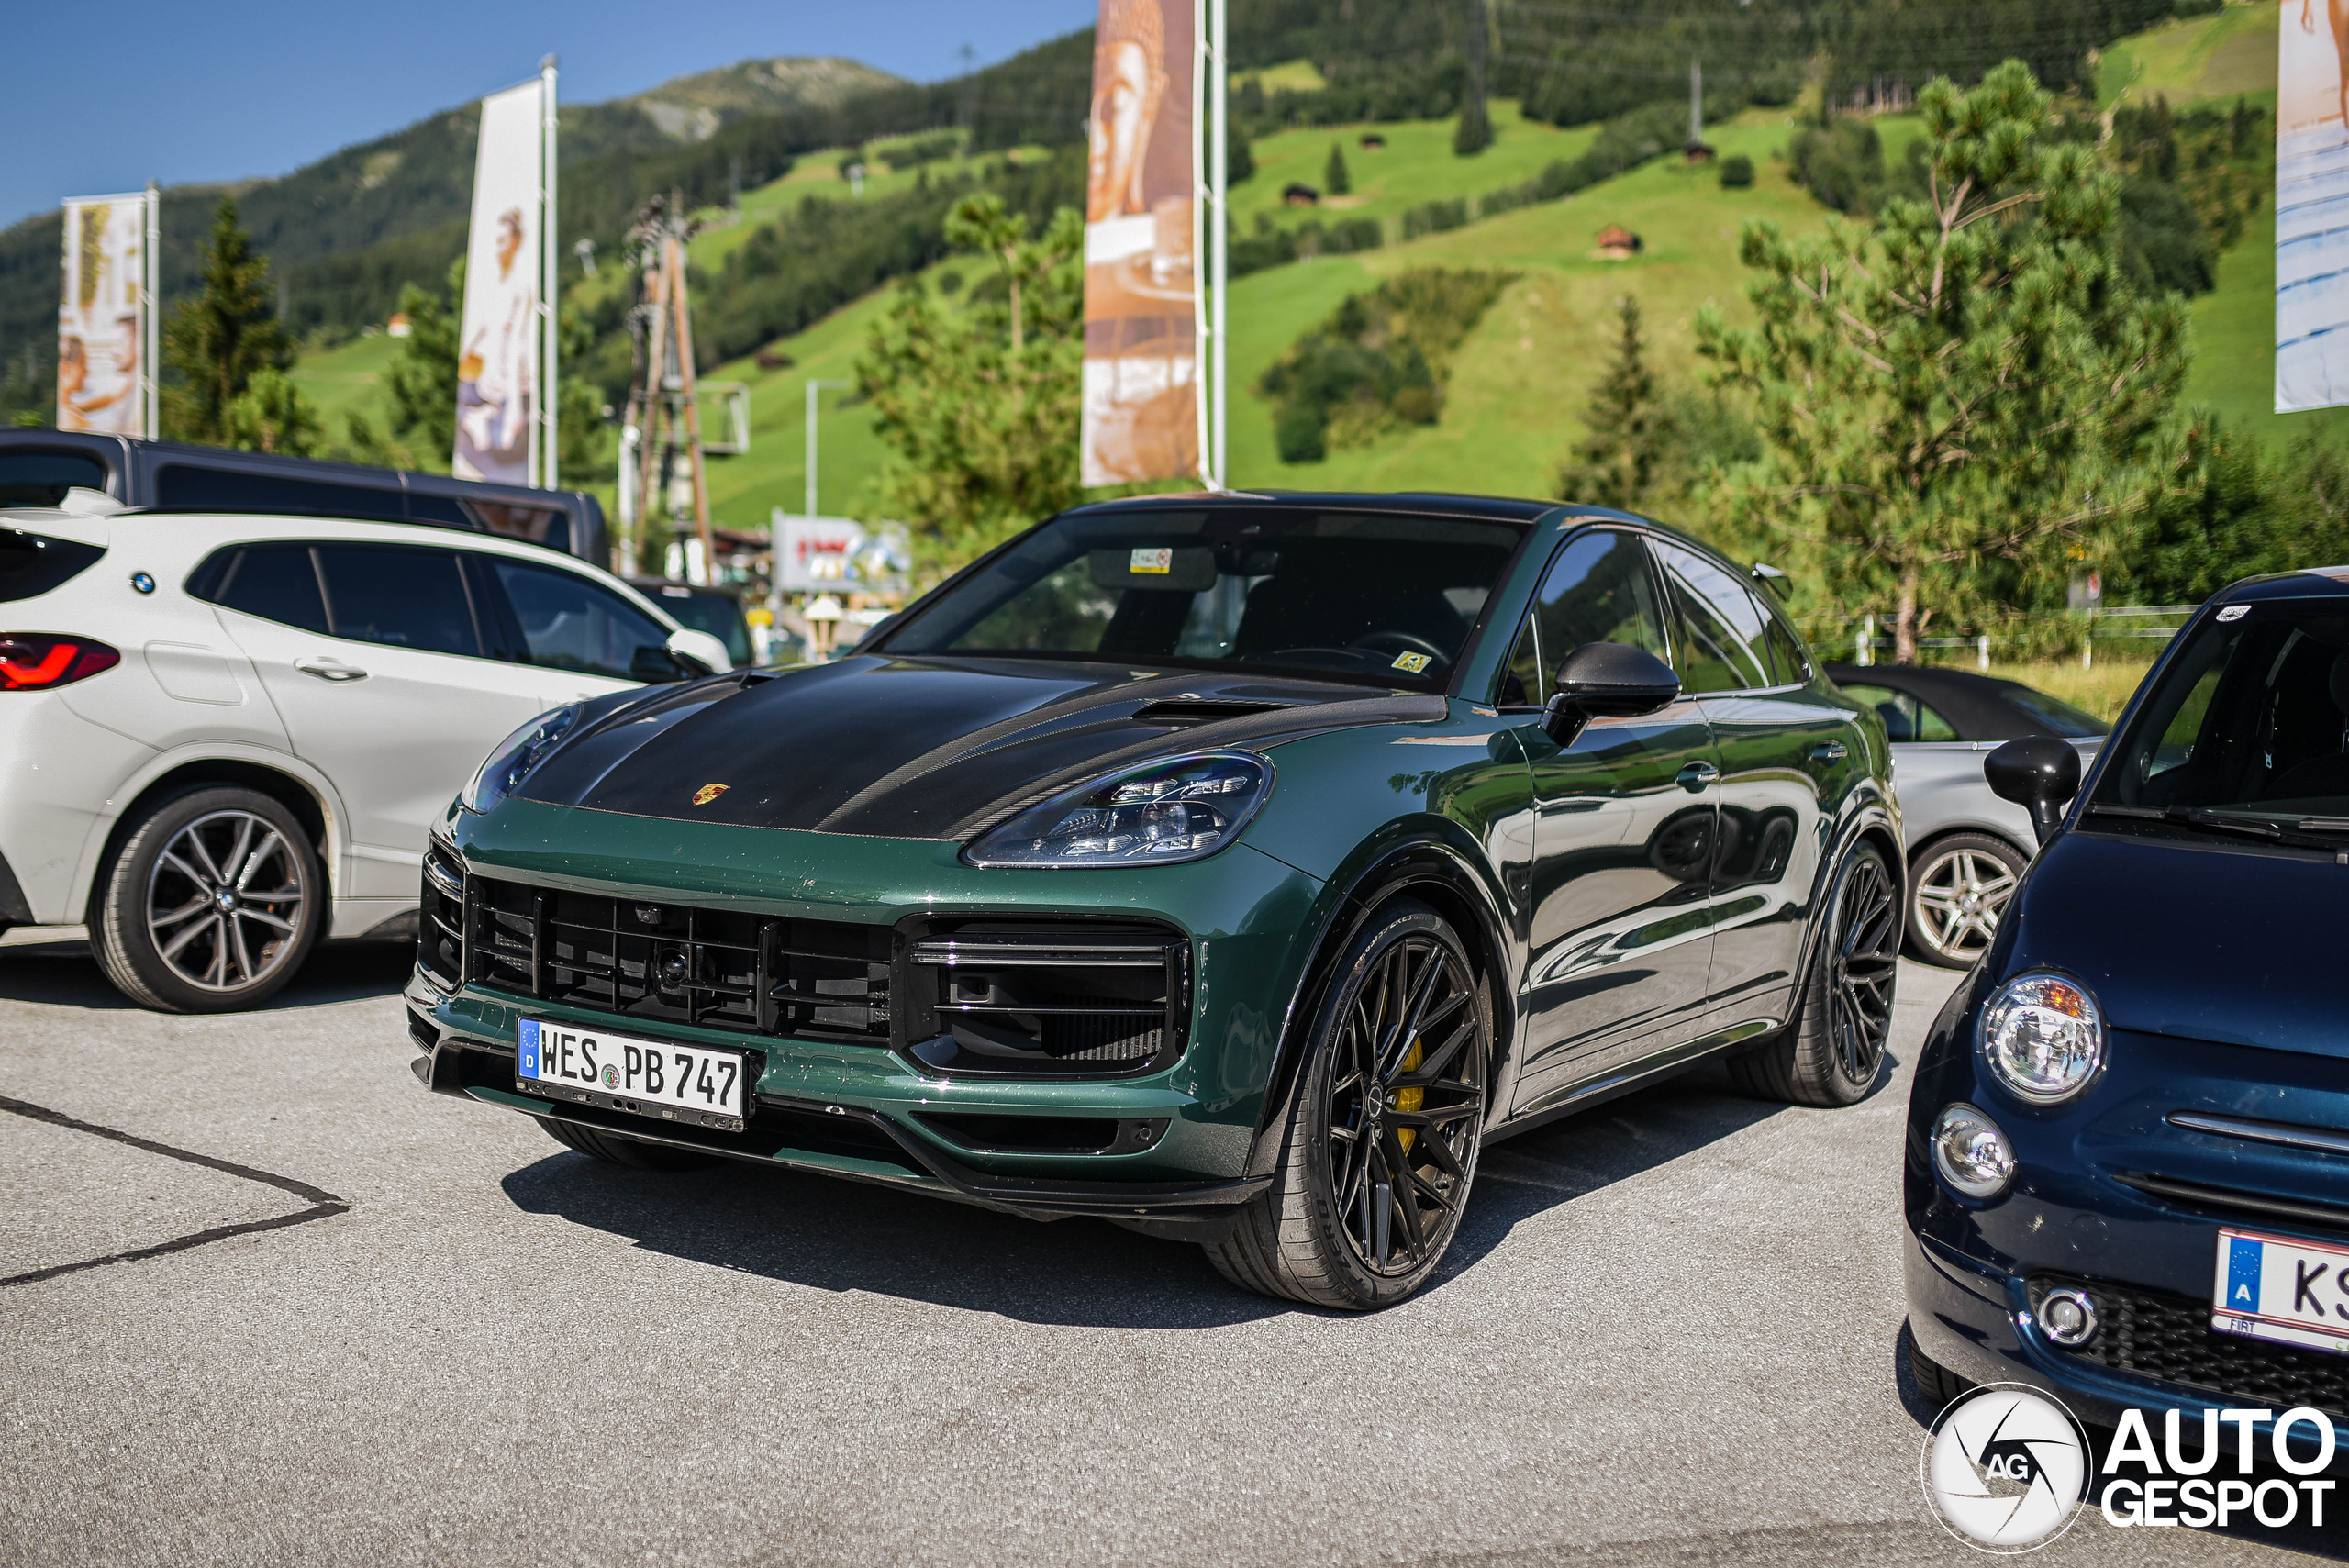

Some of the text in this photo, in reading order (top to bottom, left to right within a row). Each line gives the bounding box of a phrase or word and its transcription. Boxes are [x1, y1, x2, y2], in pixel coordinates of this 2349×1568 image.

[526, 1055, 534, 1068] D
[541, 1029, 597, 1083] WES
[623, 1045, 664, 1094] PB
[674, 1053, 737, 1106] 747
[2234, 1284, 2252, 1301] A
[2230, 1318, 2255, 1333] FIAT
